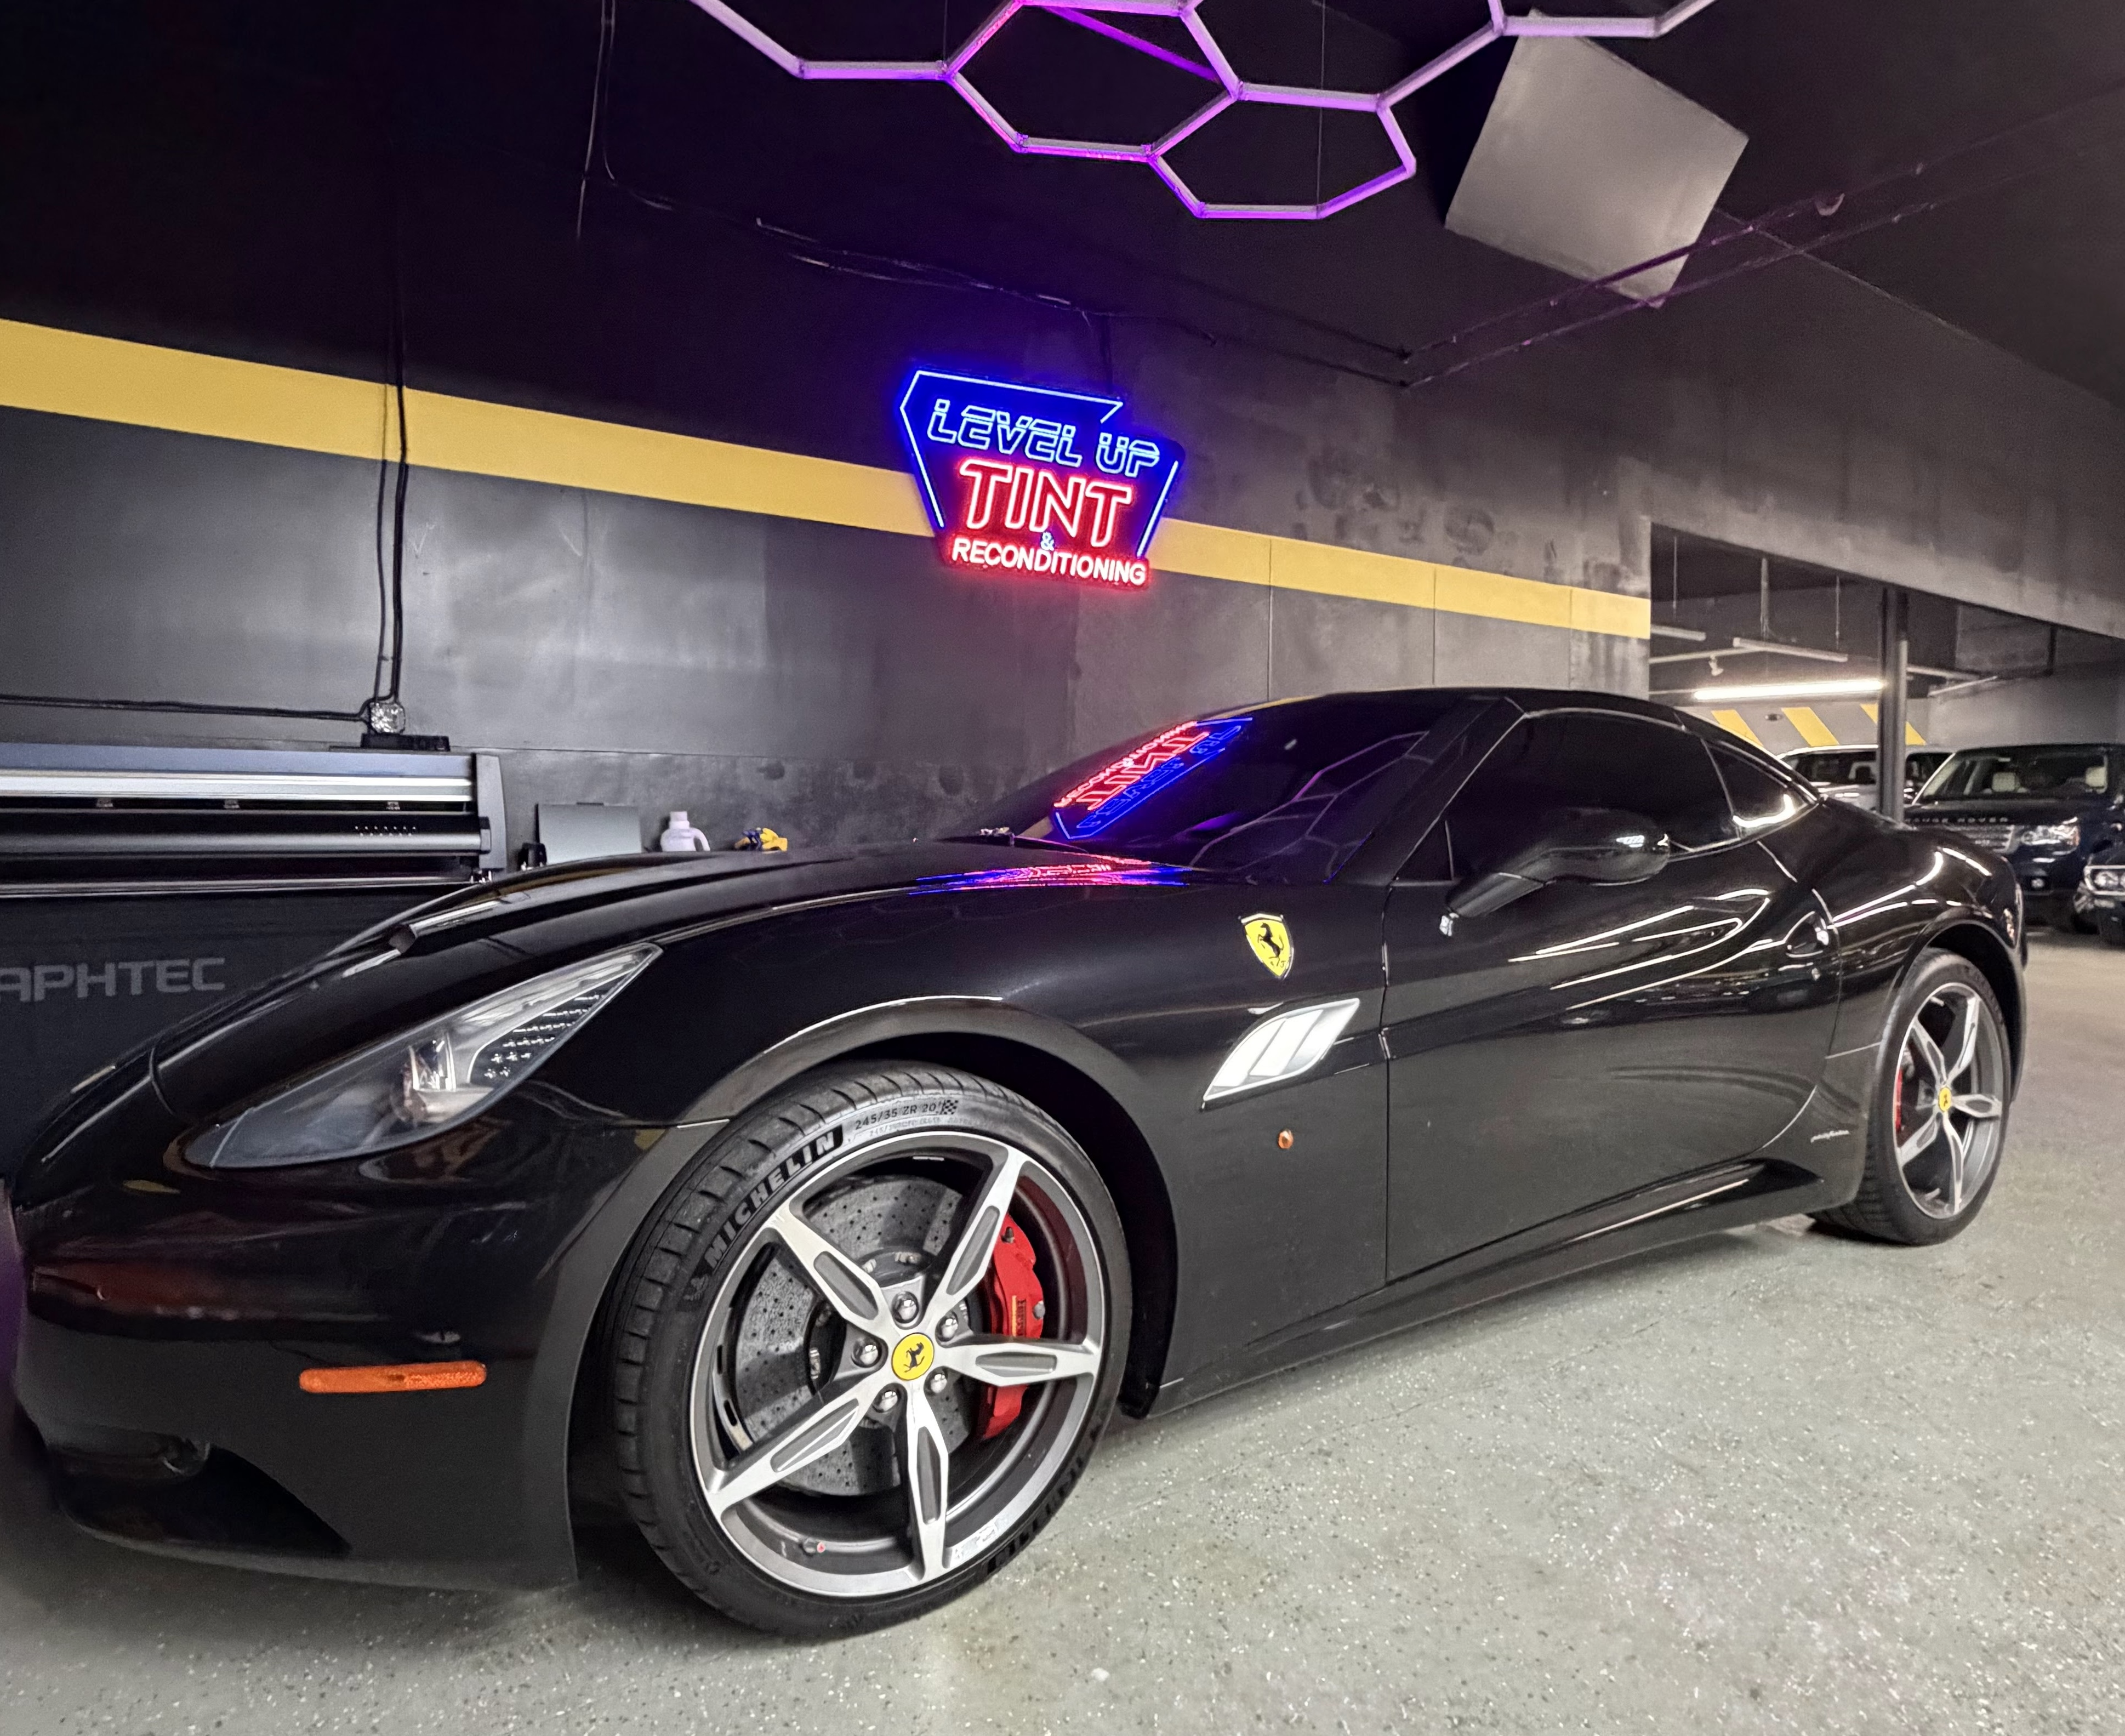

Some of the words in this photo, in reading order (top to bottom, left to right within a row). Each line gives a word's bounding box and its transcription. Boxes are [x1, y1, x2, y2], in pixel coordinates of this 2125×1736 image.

[927, 399, 1083, 468] LEVEL
[1095, 432, 1160, 477] UP
[959, 459, 1132, 548] TINT
[952, 538, 1146, 585] RECONDITIONING
[1040, 532, 1055, 551] &
[0, 958, 225, 1001] APHTEC
[856, 1108, 898, 1130] 245/35
[921, 1103, 937, 1113] 20
[704, 1131, 835, 1268] MICHELIN
